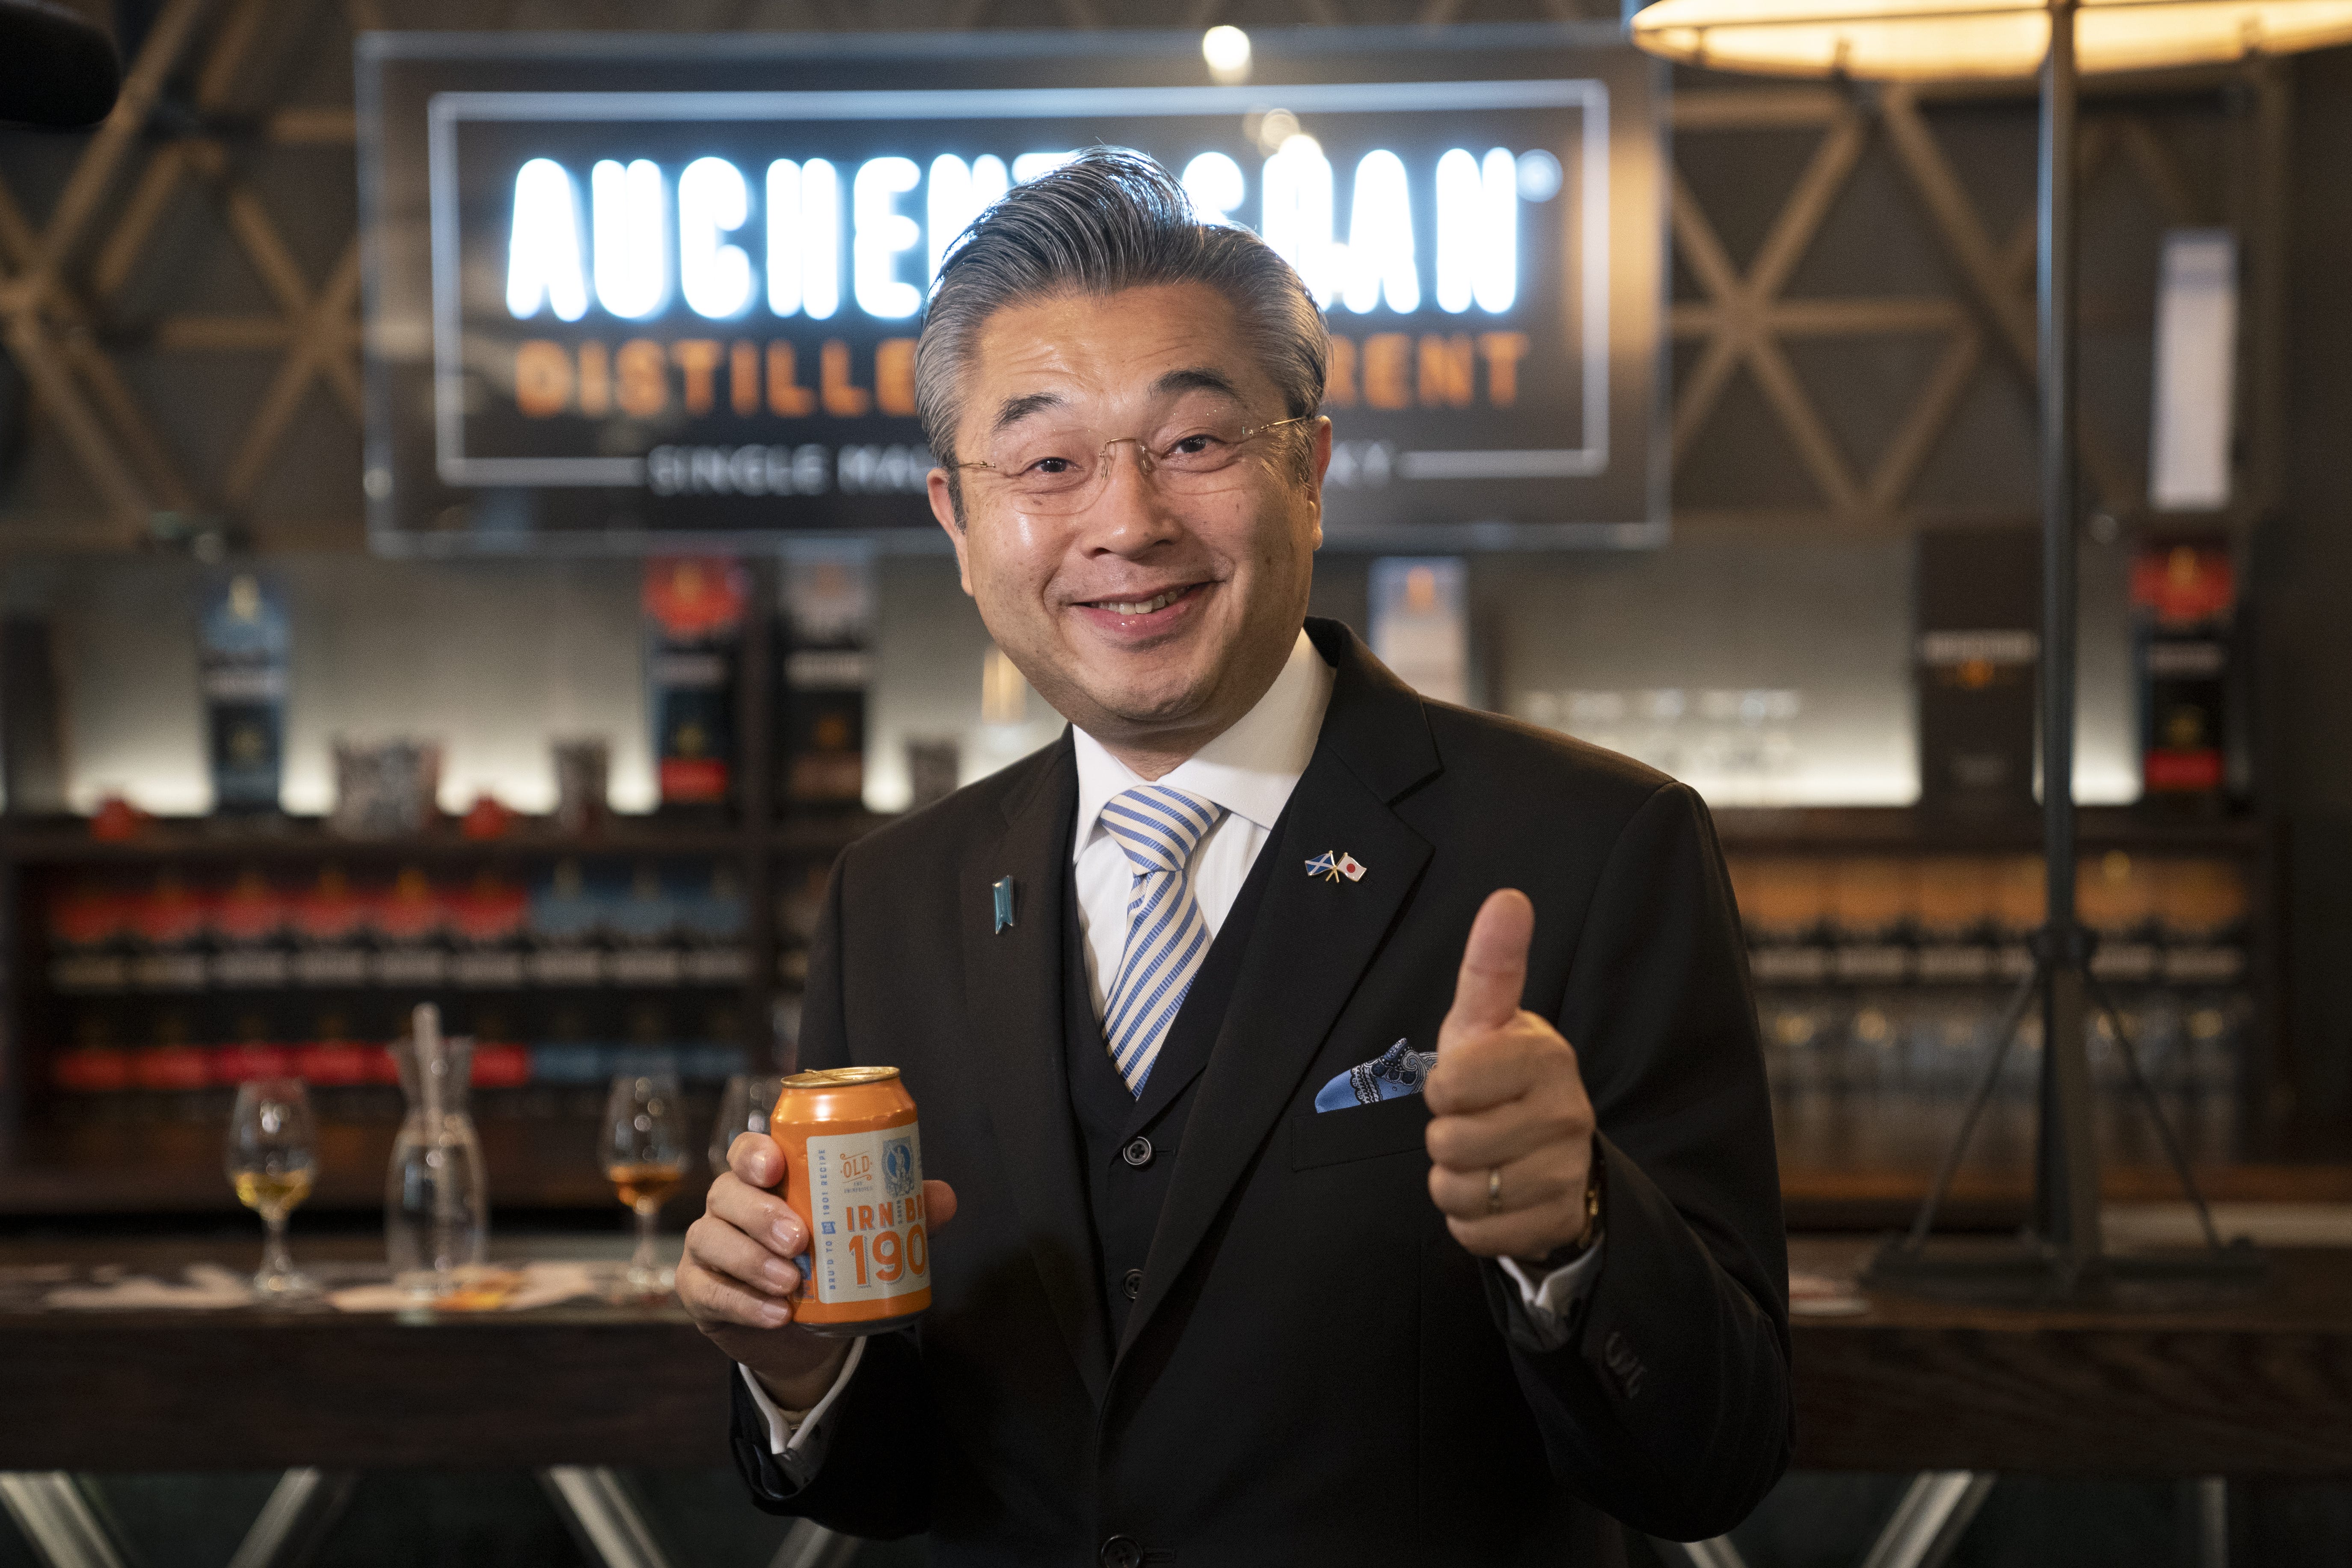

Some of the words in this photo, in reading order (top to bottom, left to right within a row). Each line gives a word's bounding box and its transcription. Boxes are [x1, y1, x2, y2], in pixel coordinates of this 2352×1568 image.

[513, 340, 916, 417] DISTILLE
[837, 443, 931, 495] MAL
[819, 1149, 828, 1186] RECIPE
[843, 1155, 869, 1178] OLD
[846, 1202, 894, 1231] IRN
[826, 1240, 832, 1253] TO
[848, 1224, 925, 1286] 190
